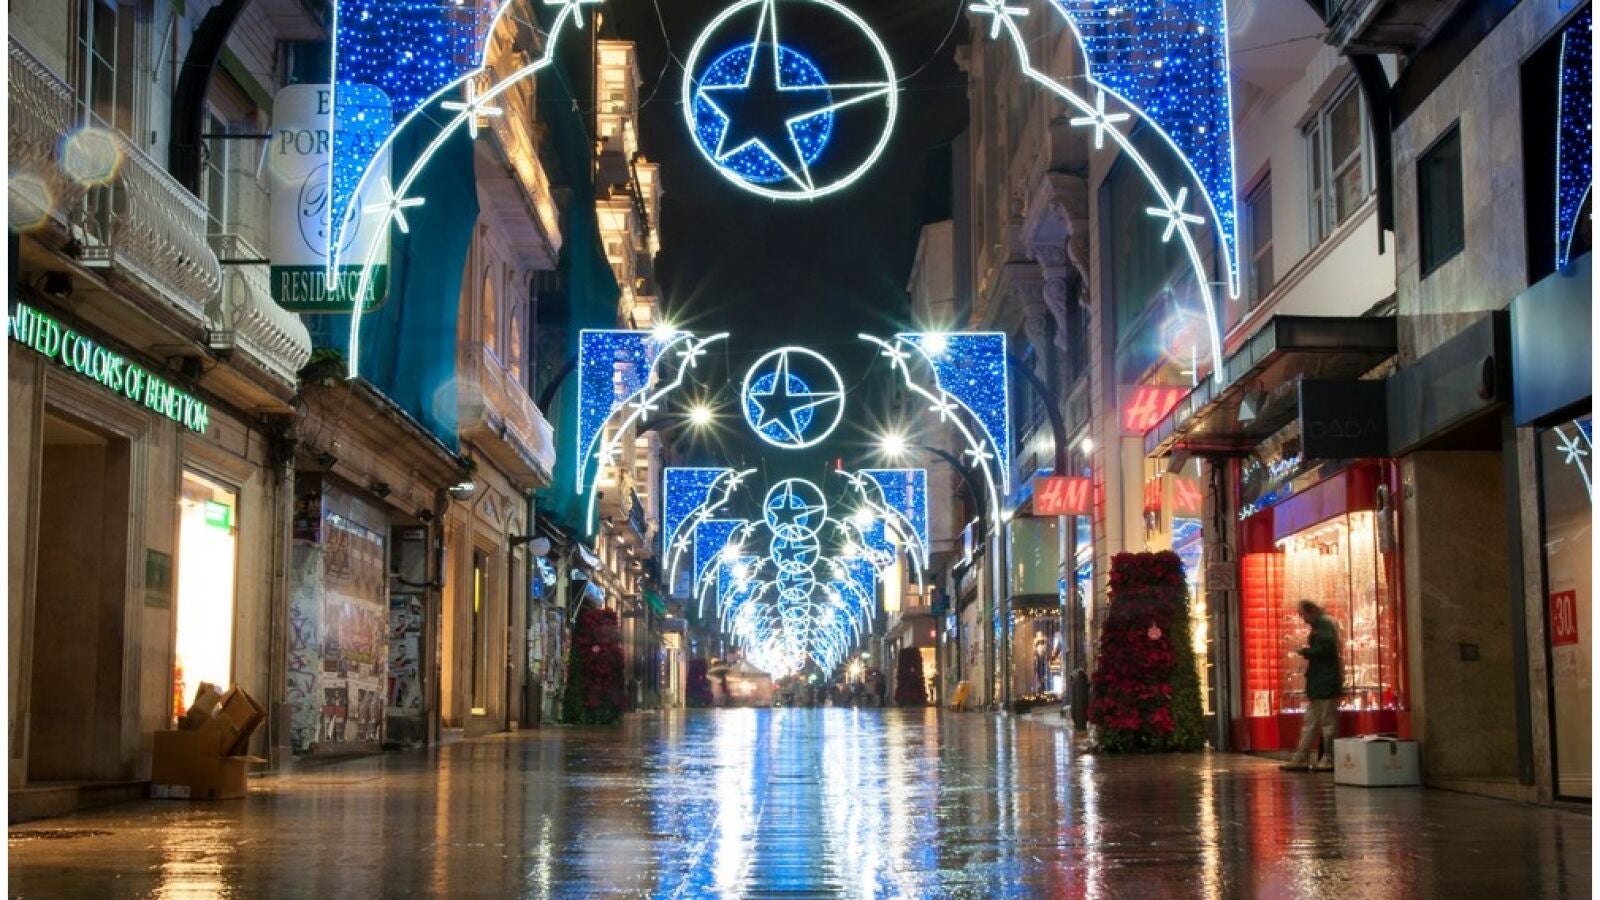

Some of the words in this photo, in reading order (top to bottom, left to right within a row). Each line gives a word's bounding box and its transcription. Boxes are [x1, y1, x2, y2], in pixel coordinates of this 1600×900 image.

[281, 270, 375, 302] RESIDNCA
[62, 330, 123, 391] COLORS
[125, 363, 145, 402] OF
[1039, 479, 1088, 512] H&M
